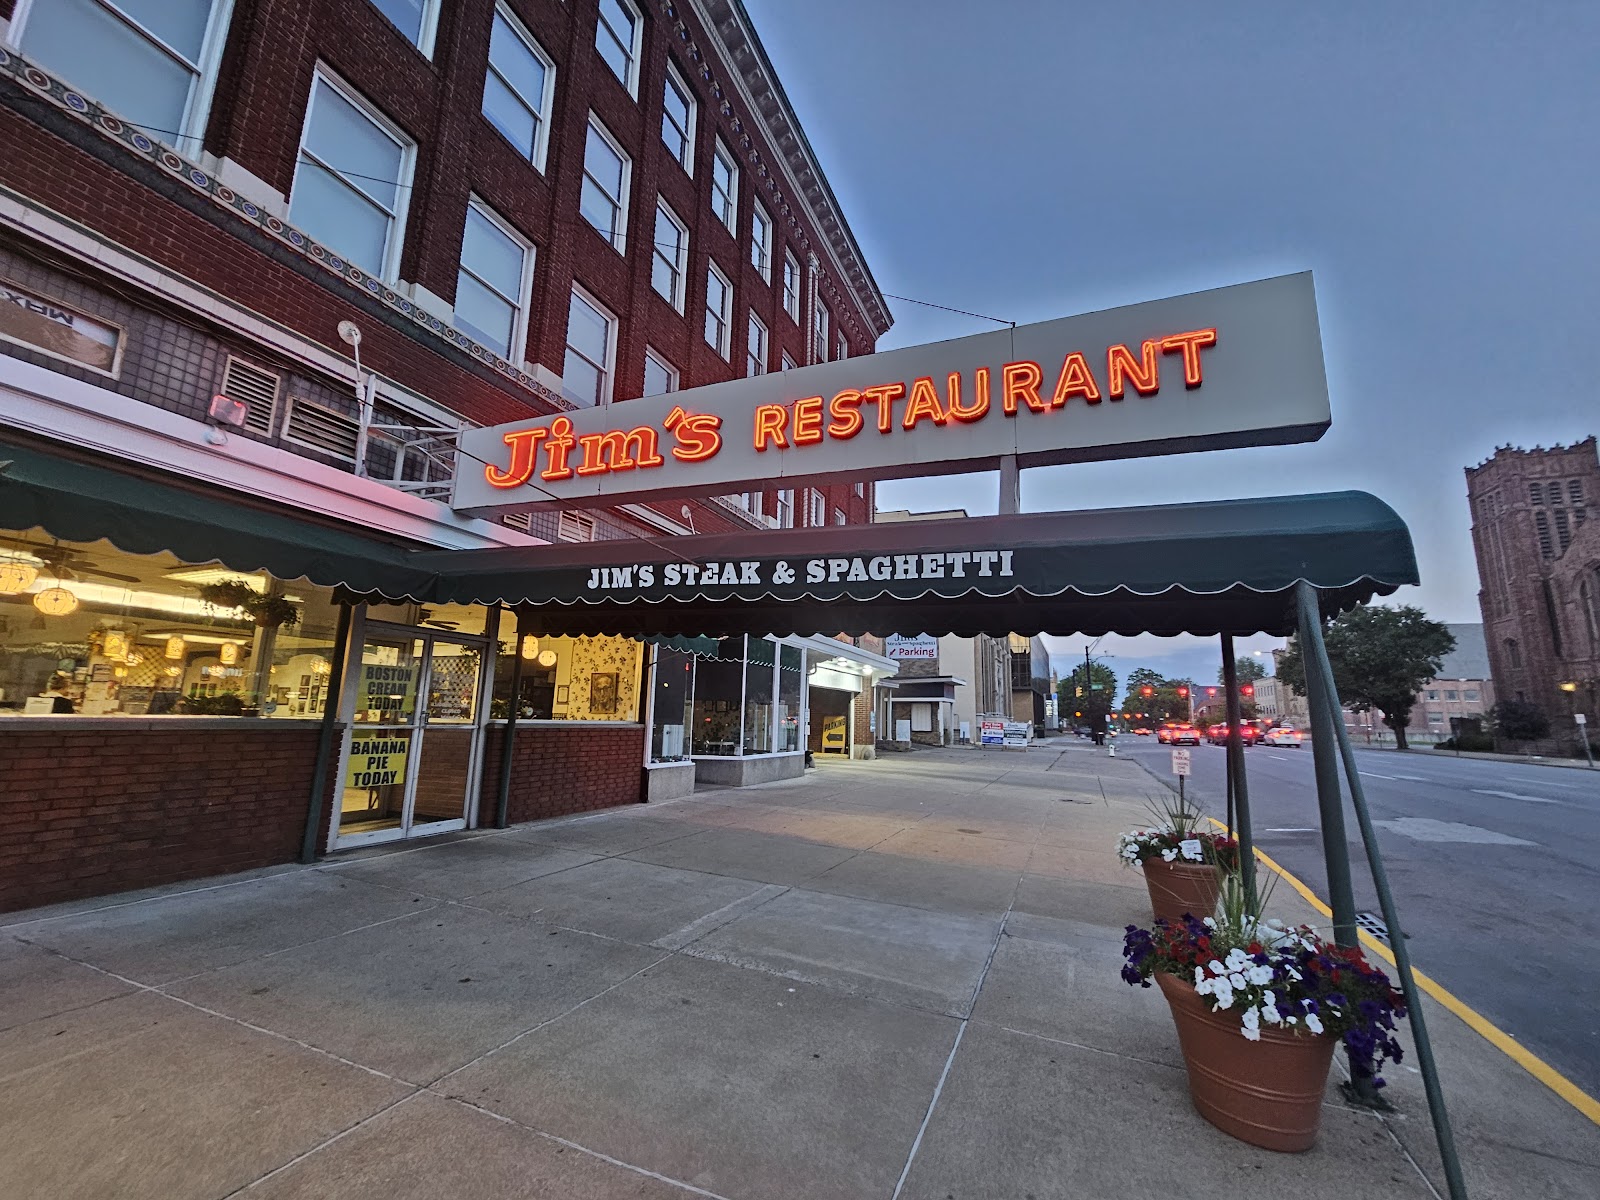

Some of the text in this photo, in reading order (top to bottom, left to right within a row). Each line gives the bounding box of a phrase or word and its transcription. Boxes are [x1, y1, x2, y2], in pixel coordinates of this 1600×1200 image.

[484, 328, 1217, 489] Jim's RESTAURANT
[587, 550, 1014, 589] JIM'S STEAK & SPAGHETTI
[898, 648, 934, 657] Parking
[366, 667, 412, 681] BOSTON
[368, 682, 407, 696] CREAM
[368, 696, 405, 710] TODAY
[824, 717, 846, 732] PARKING
[350, 740, 406, 755] BANANA
[366, 756, 389, 770] PIE
[353, 771, 397, 786] TODAY
